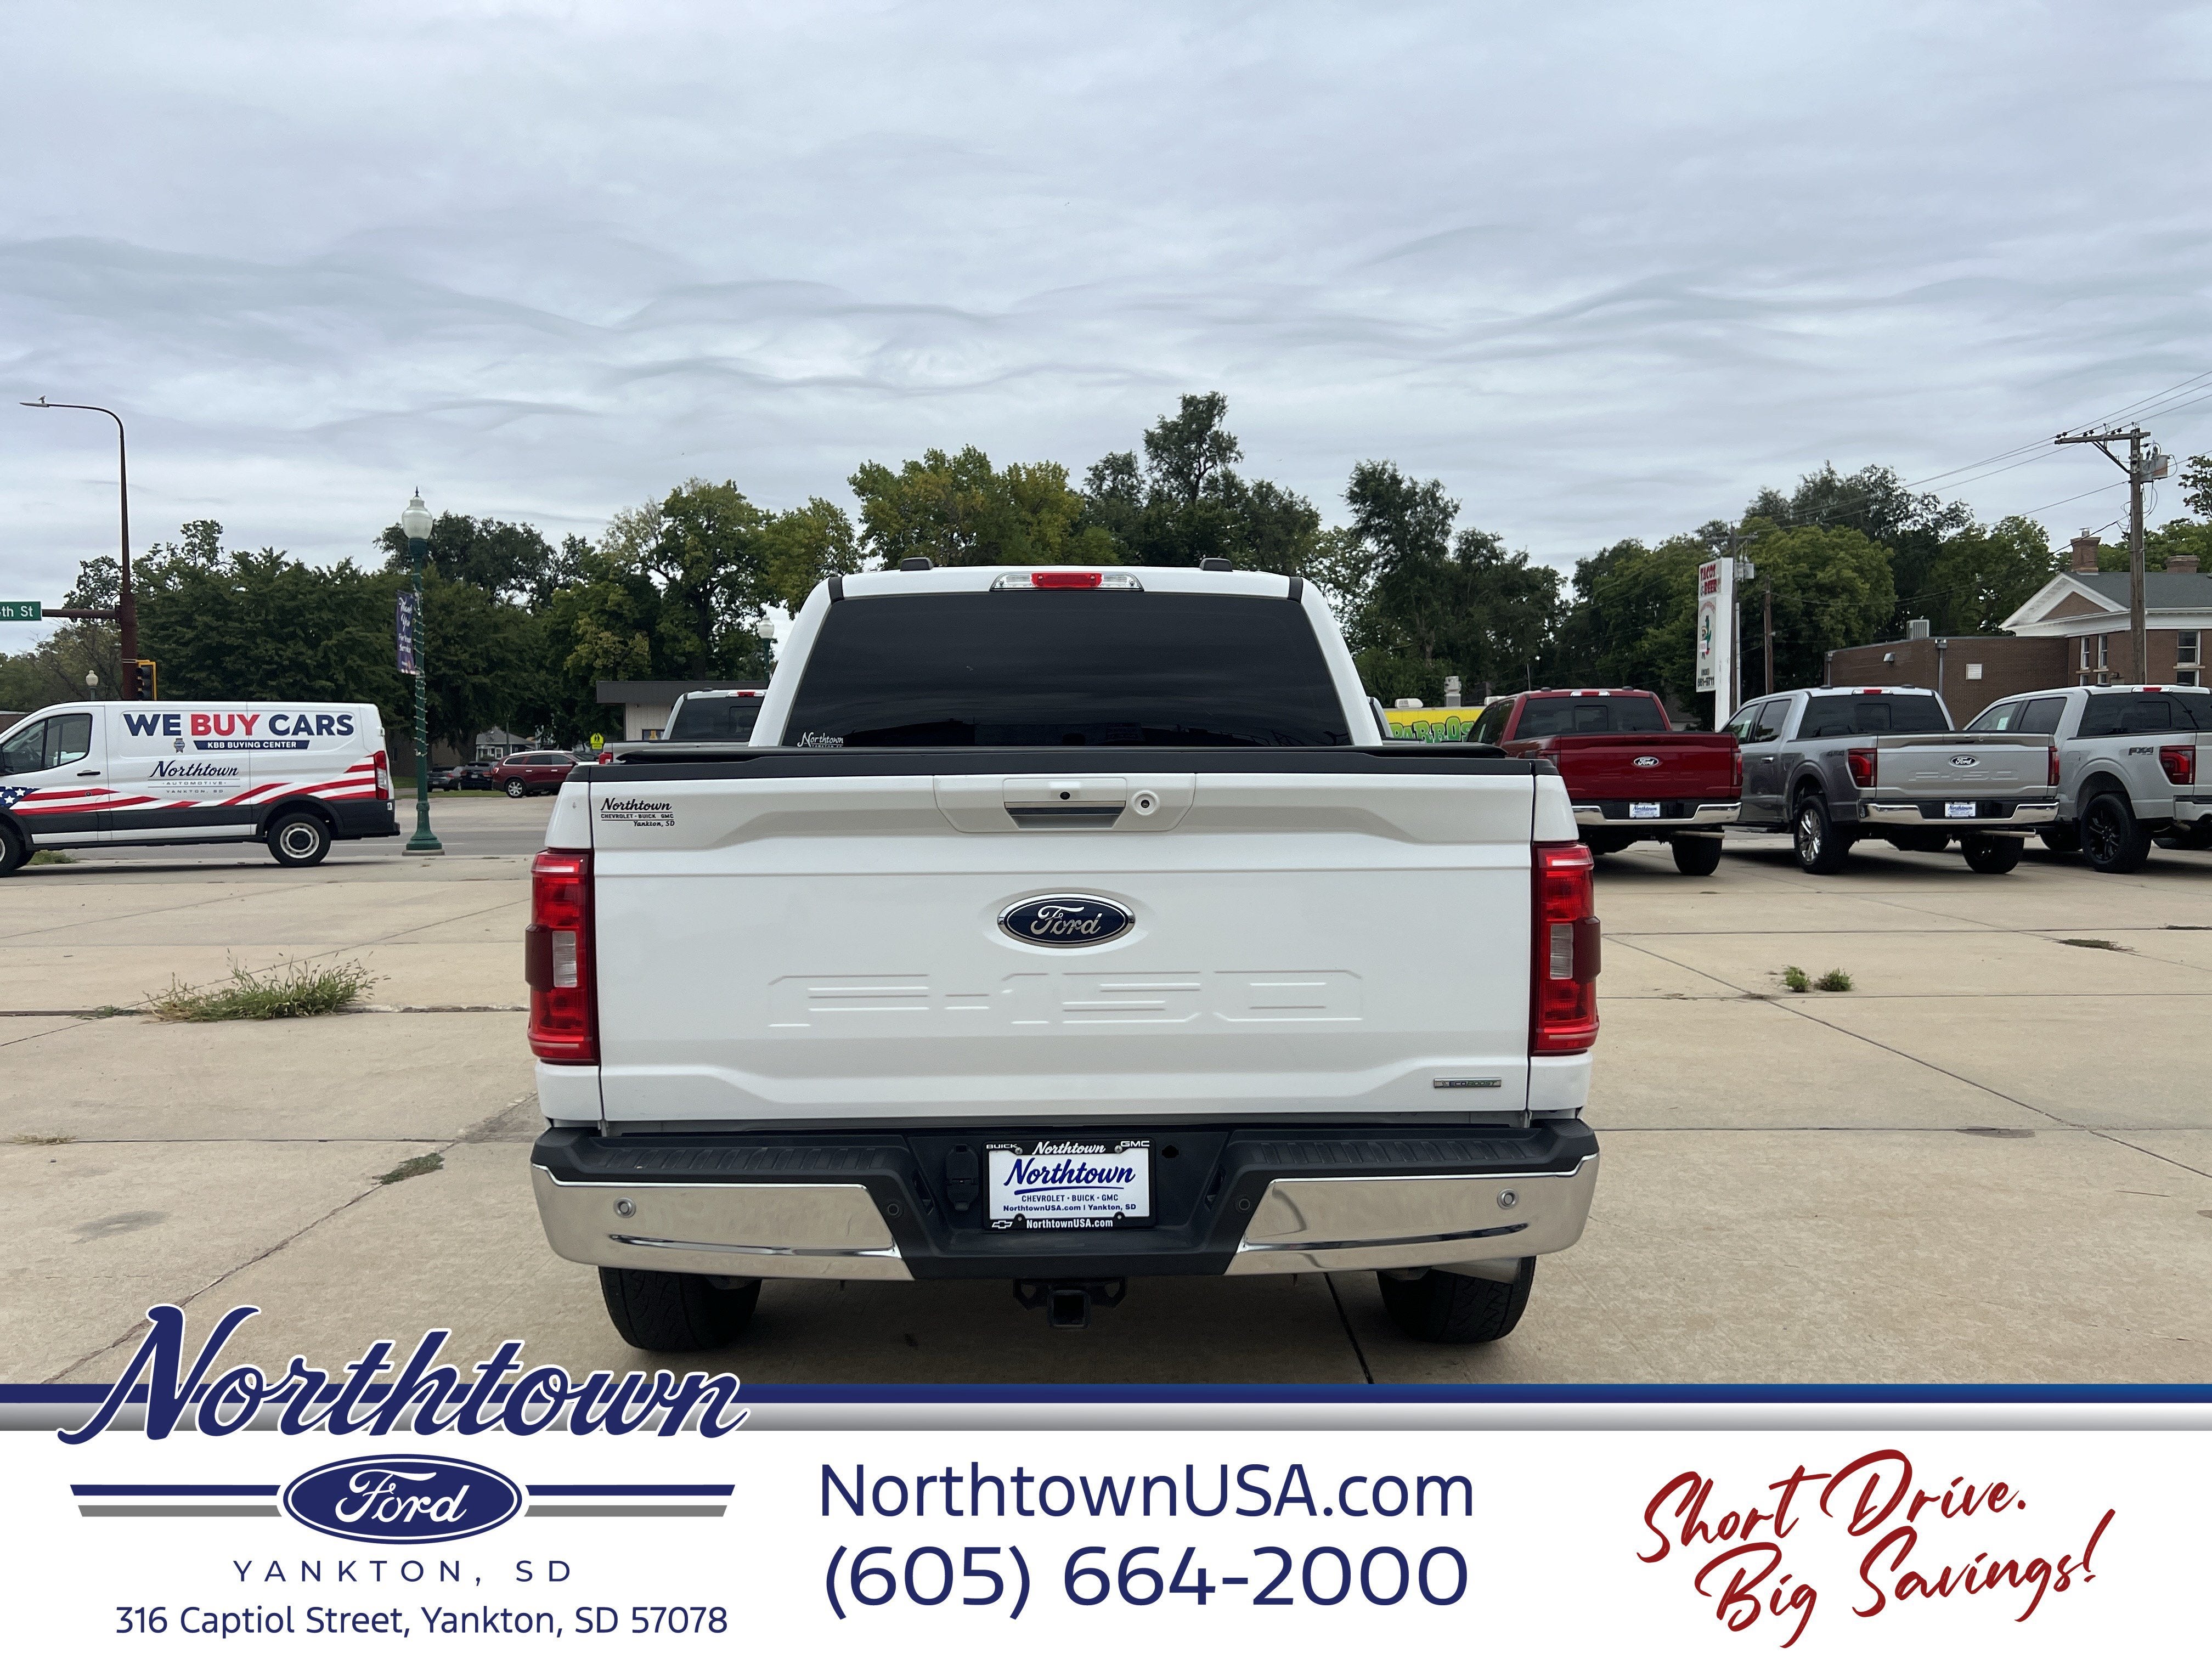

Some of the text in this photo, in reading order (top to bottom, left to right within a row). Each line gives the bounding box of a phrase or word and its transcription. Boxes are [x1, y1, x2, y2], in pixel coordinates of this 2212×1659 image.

[1700, 563, 1716, 581] TACOS
[1704, 579, 1717, 595] BEER
[0, 605, 33, 617] th St
[123, 714, 354, 736] WE BUY CARS
[797, 731, 844, 747] Northtown
[149, 760, 239, 778] Northtown
[600, 797, 672, 811] Northtown
[1030, 905, 1103, 935] Ford
[769, 968, 1363, 1027] F-150
[1031, 1141, 1106, 1155] Northtown
[1003, 1157, 1136, 1186] Northtown
[1026, 1219, 1114, 1229] NorthtownUSA.com
